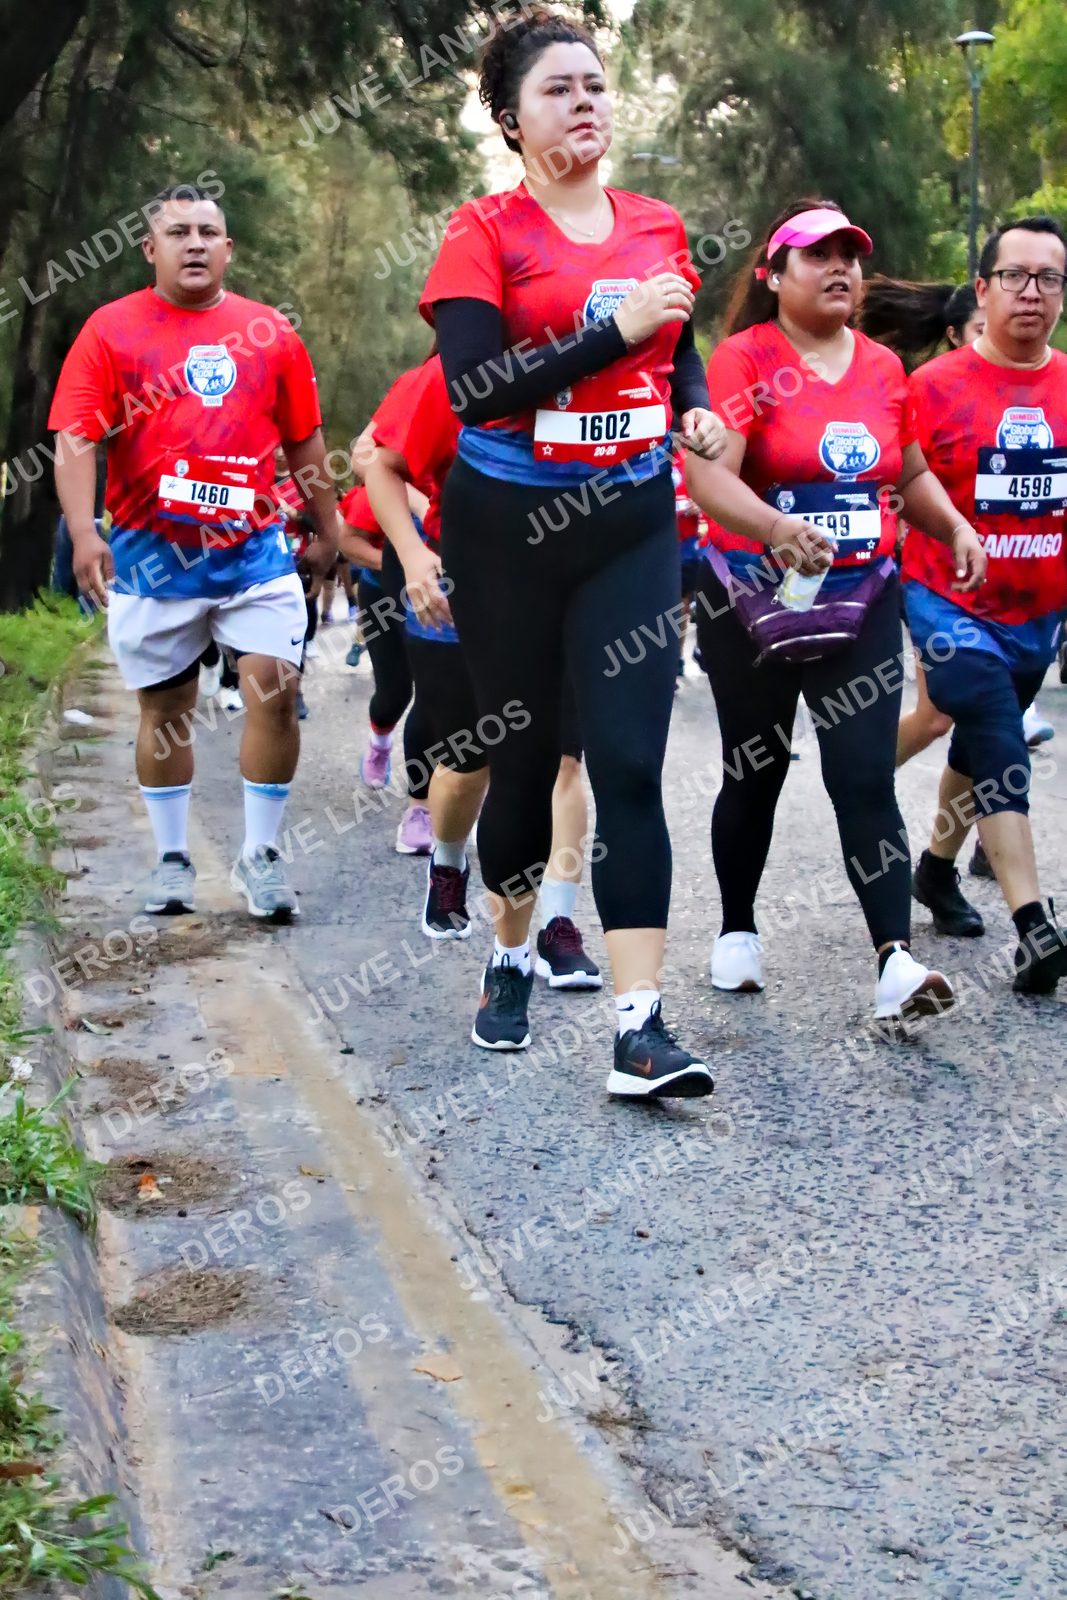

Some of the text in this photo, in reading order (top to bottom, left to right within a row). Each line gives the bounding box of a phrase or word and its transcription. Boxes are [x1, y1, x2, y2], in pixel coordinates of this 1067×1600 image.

[579, 412, 630, 442] 1602
[1010, 425, 1038, 434] Global
[834, 437, 864, 446] Global
[1006, 434, 1028, 444] Race
[594, 446, 617, 456] 20-26
[830, 446, 853, 454] Race
[1008, 476, 1052, 498] 4598
[191, 482, 229, 506] 1460
